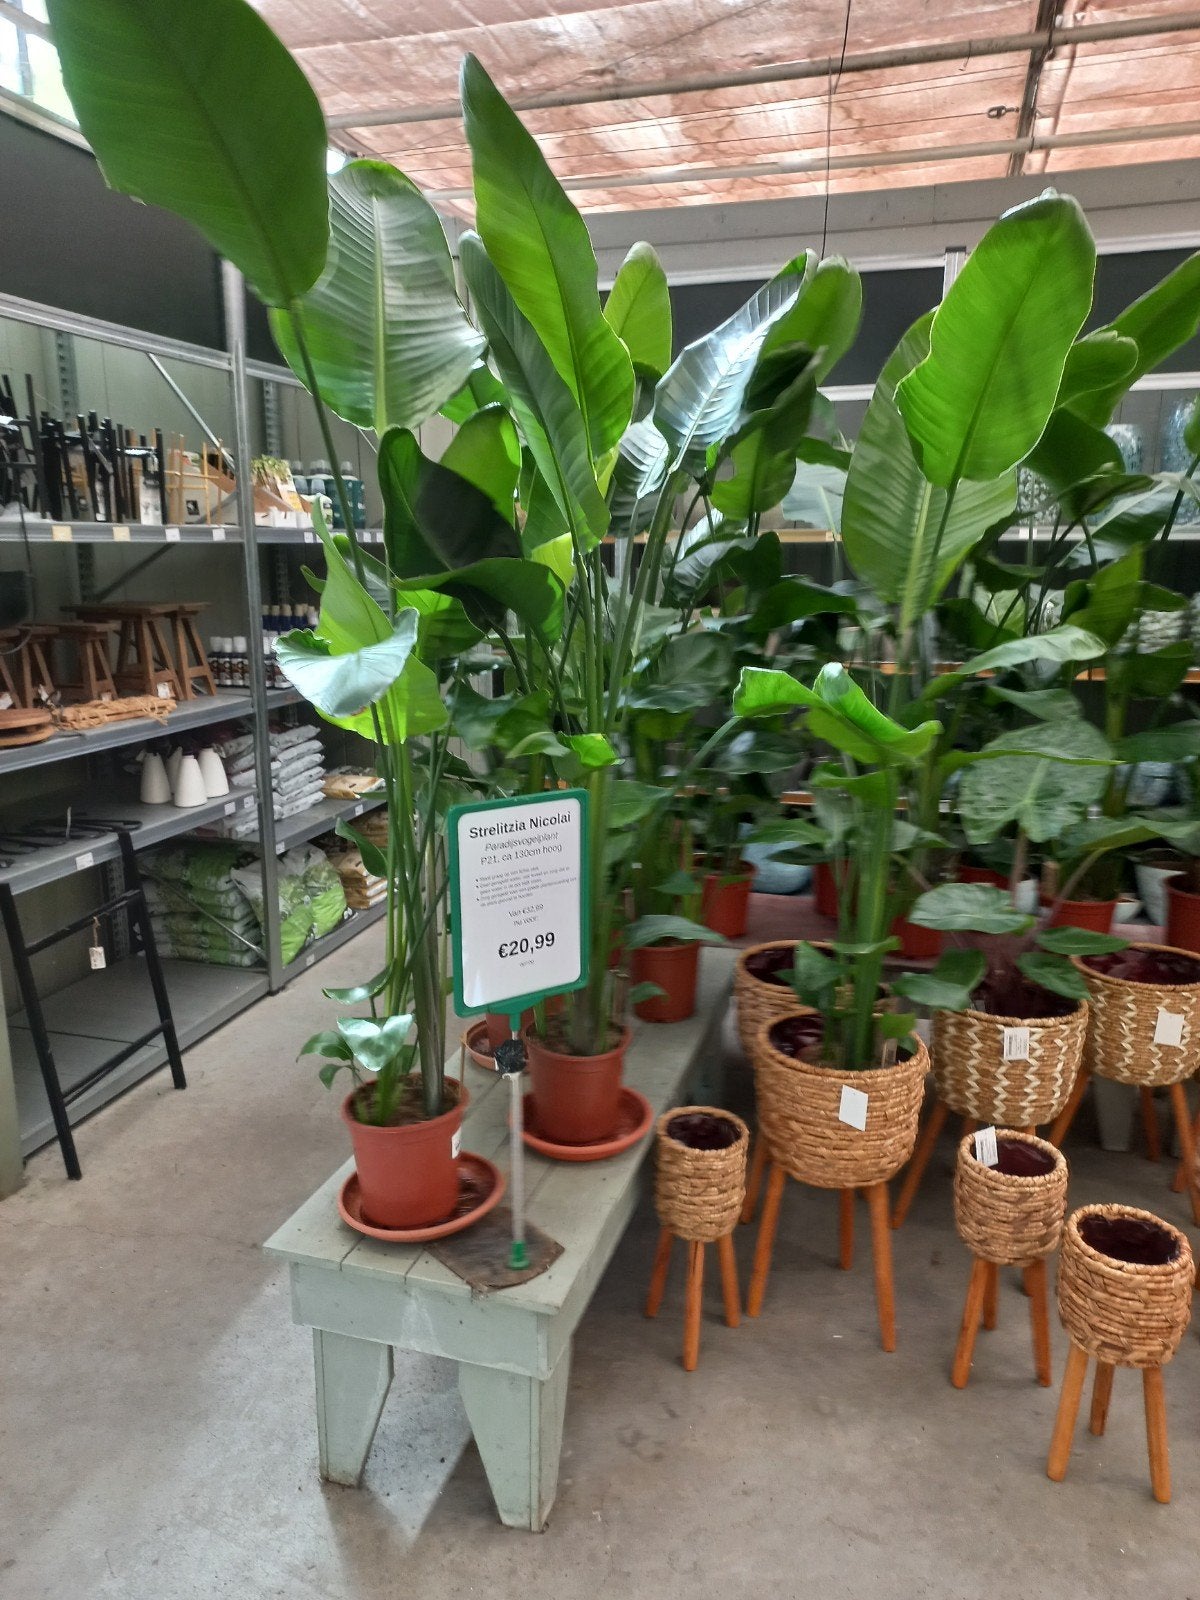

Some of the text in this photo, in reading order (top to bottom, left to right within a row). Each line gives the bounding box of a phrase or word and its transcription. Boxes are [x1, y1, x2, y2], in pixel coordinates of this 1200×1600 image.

[469, 811, 571, 839] Strelitzia Nicolai
[498, 932, 555, 959] €20,99
